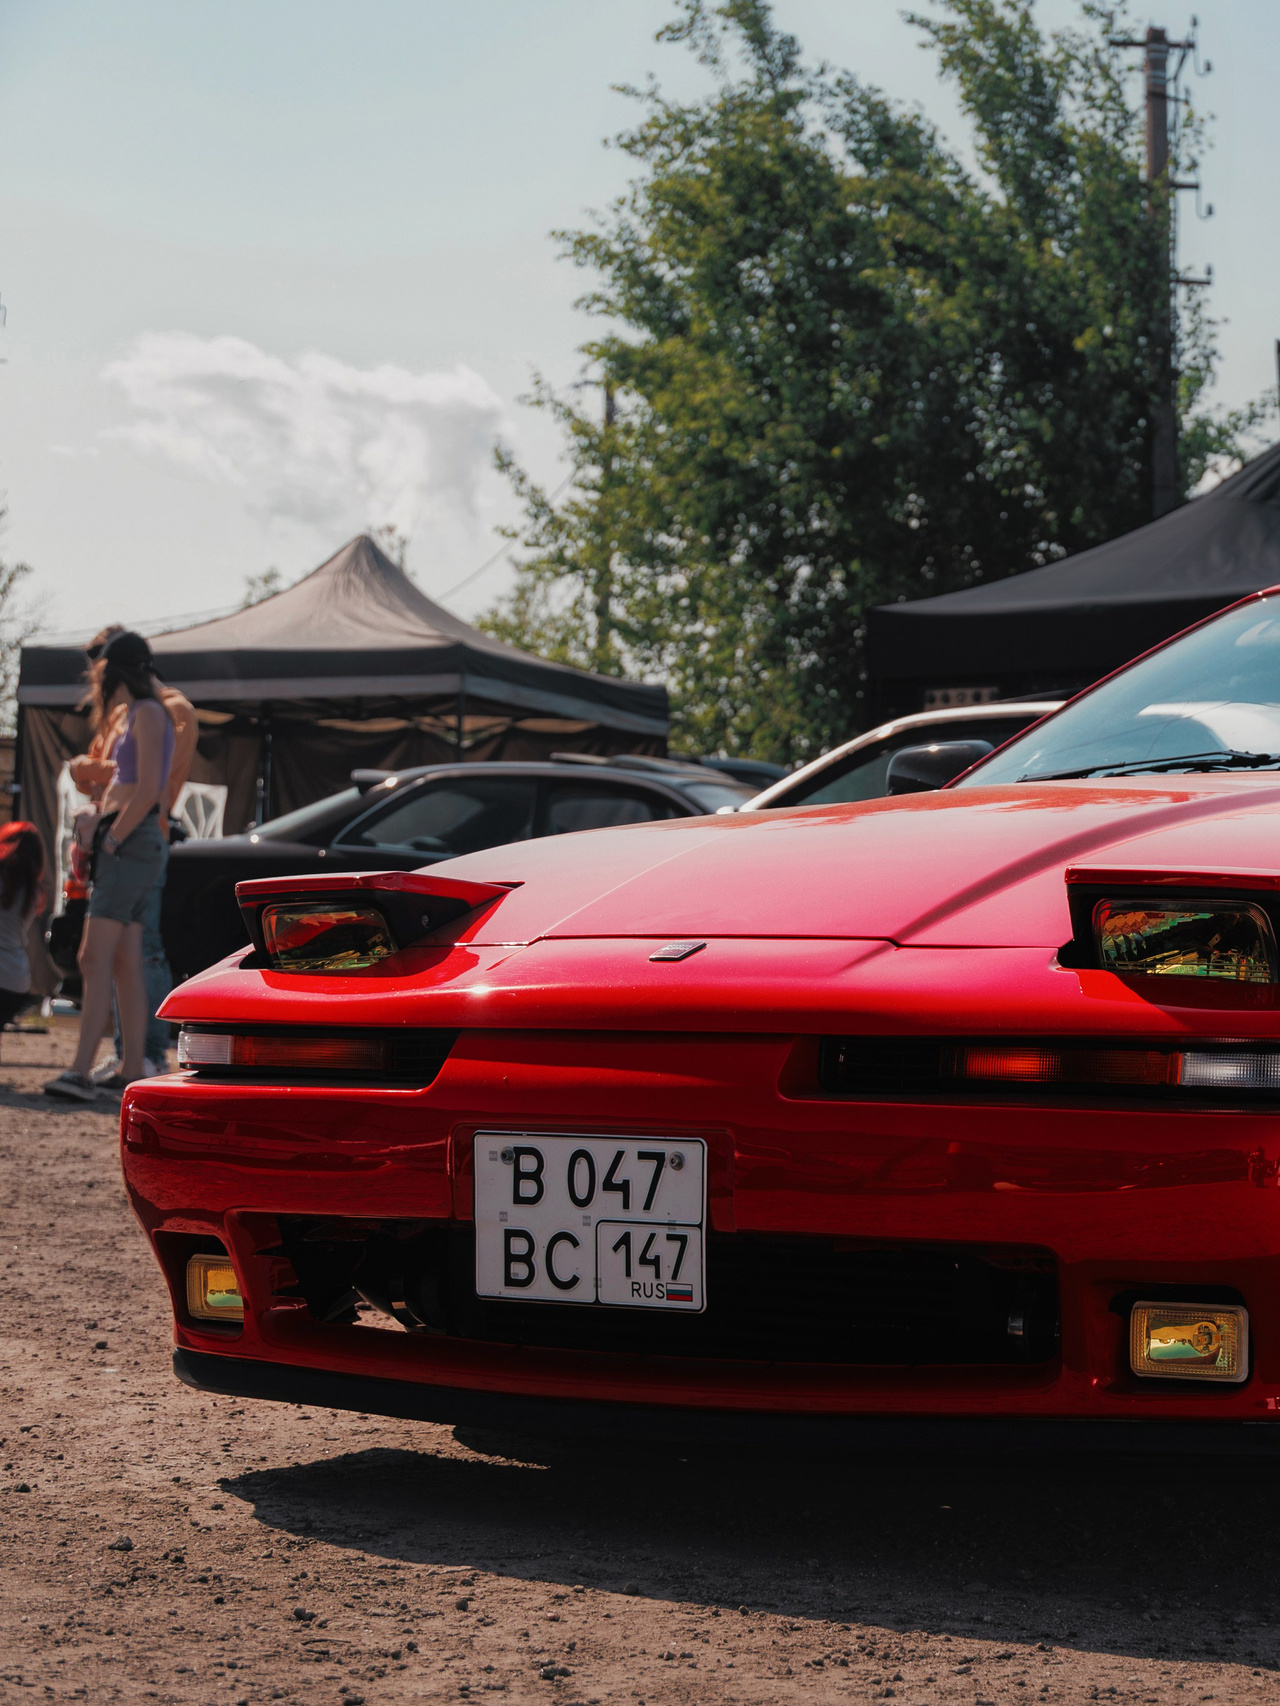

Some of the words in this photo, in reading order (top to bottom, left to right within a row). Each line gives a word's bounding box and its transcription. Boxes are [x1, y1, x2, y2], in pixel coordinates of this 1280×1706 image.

[513, 1146, 545, 1205] B
[567, 1148, 666, 1211] 047
[504, 1228, 581, 1290] BC
[612, 1231, 688, 1280] 147
[631, 1282, 665, 1299] RUS
